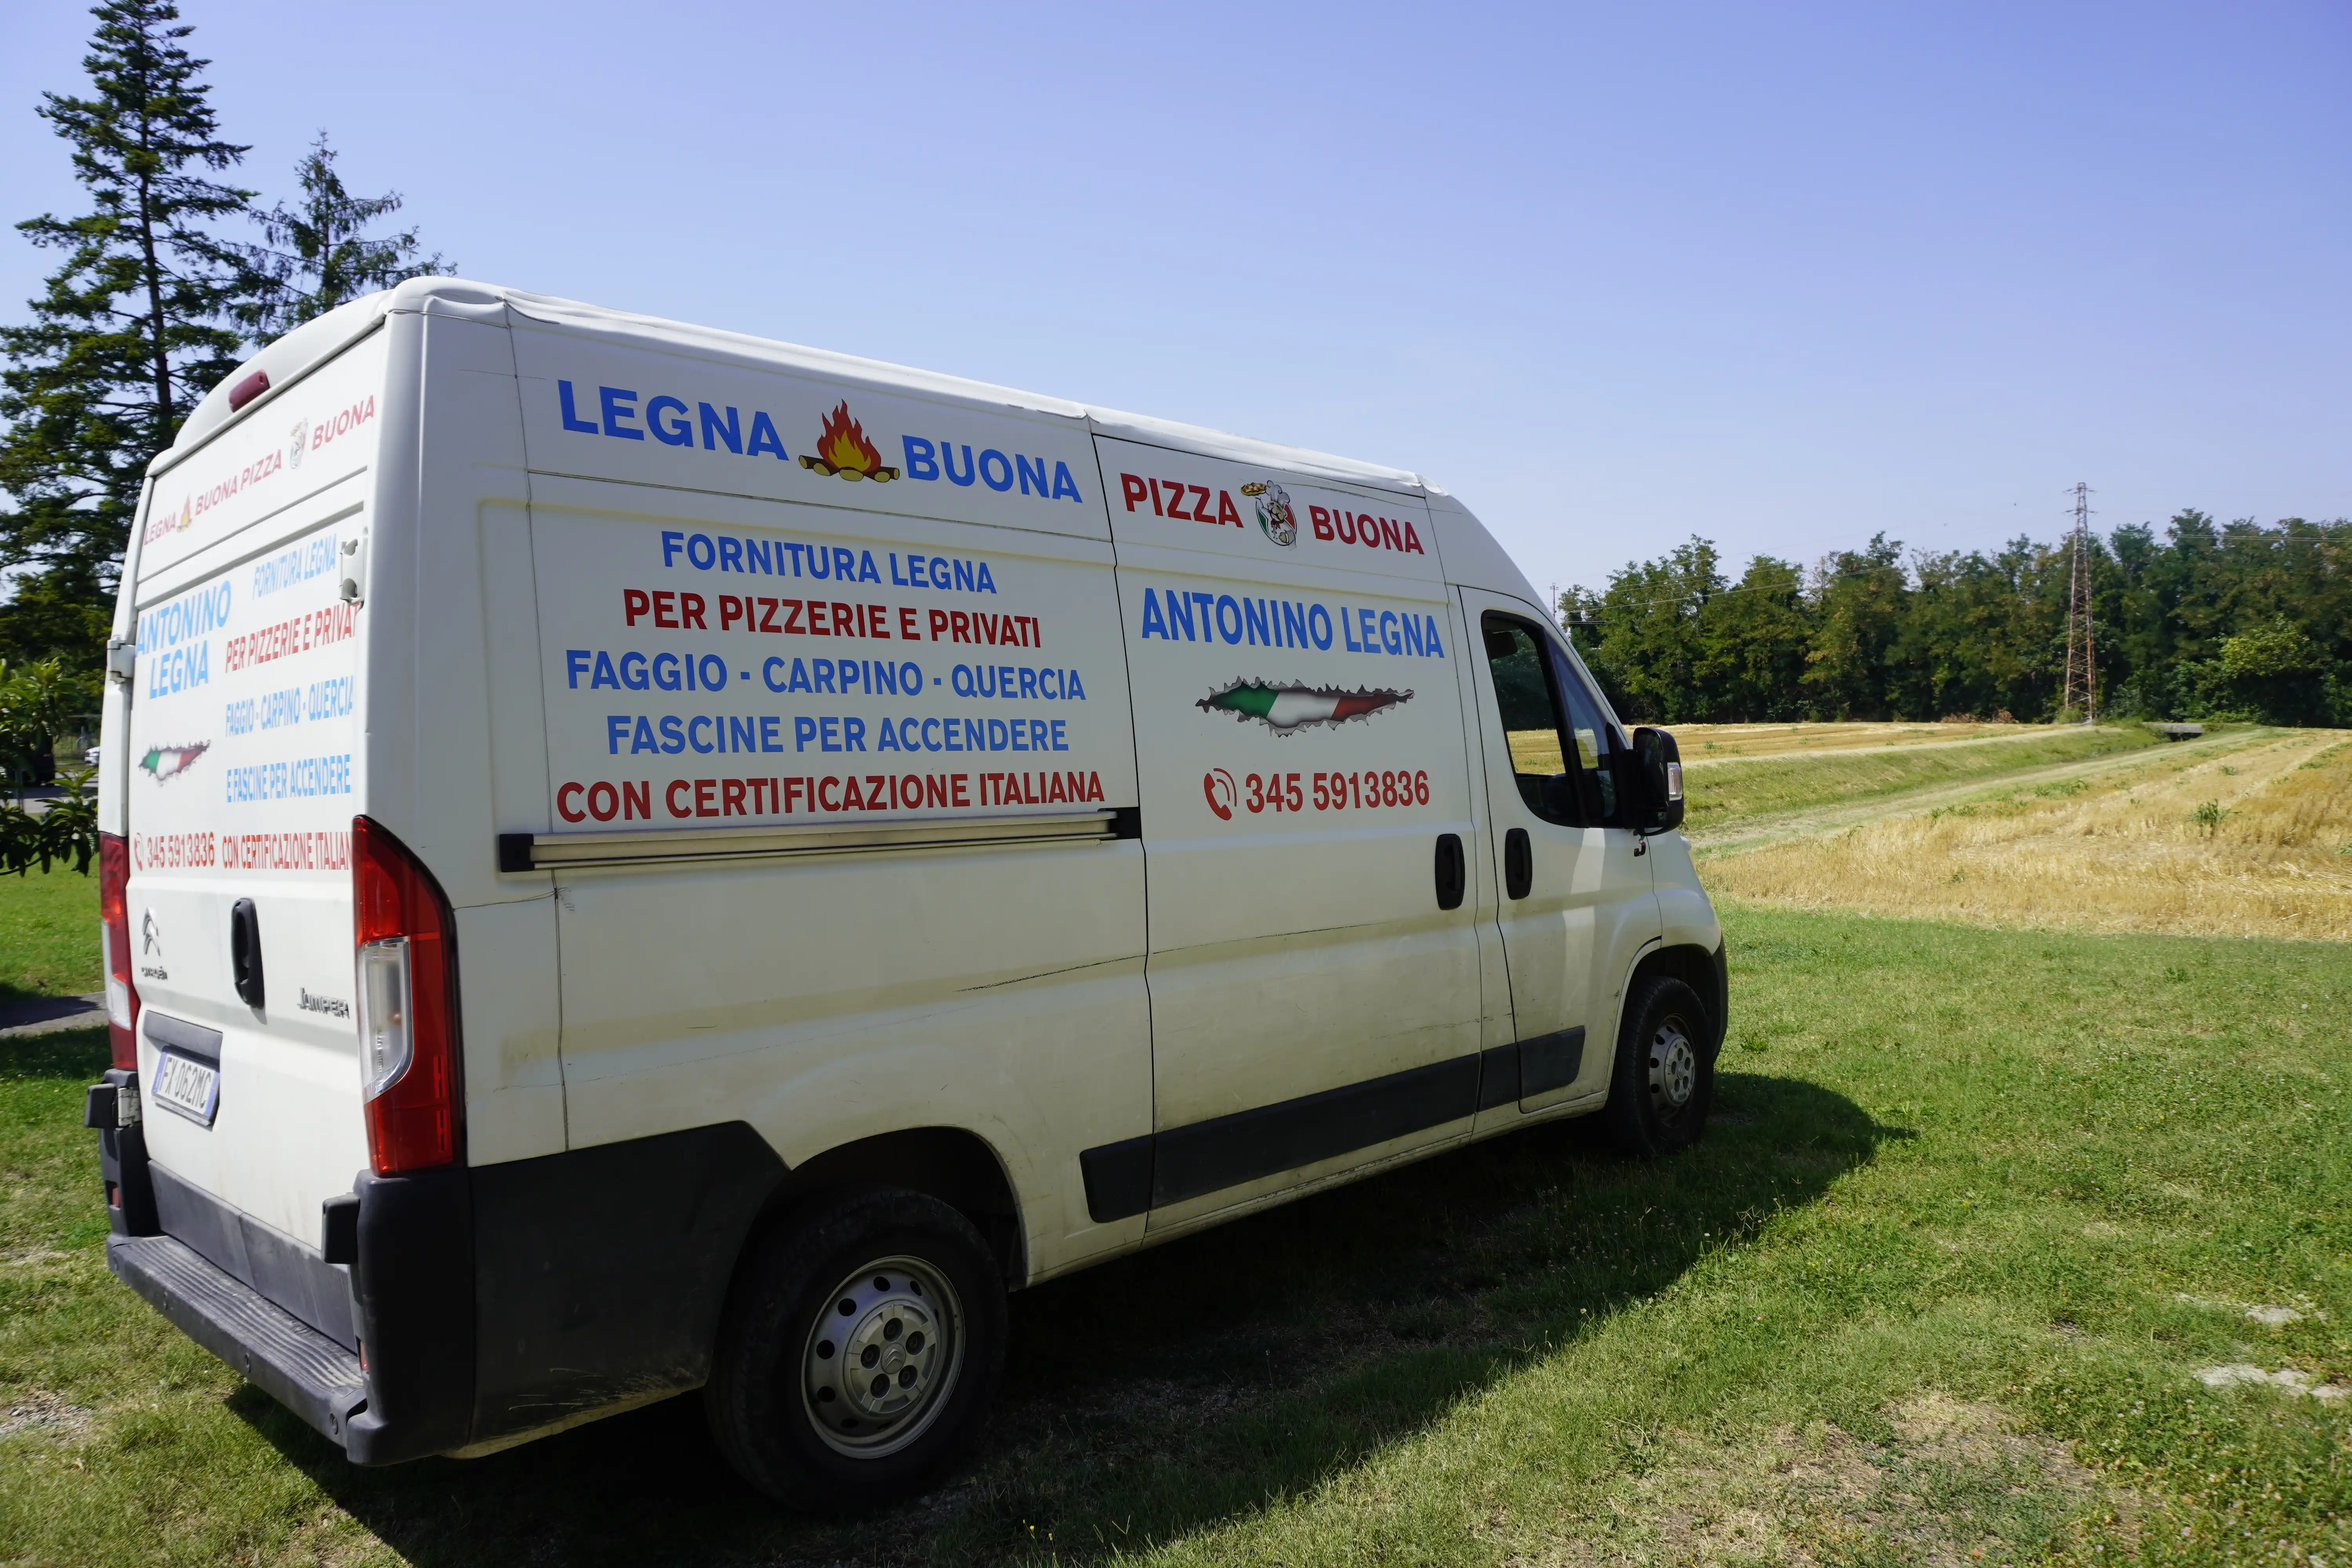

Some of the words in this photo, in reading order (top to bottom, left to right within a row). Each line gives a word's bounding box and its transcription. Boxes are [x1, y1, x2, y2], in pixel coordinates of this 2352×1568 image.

[143, 512, 176, 546] LEGNA
[195, 475, 238, 516] BUONA
[240, 449, 282, 490] PIZZA
[312, 395, 375, 451] BUONA
[557, 380, 788, 460] LEGNA
[902, 435, 1082, 503] BUONA
[1121, 473, 1244, 528] PIZZA
[1309, 505, 1425, 554] BUONA
[253, 548, 301, 600] FORNITURA
[304, 533, 336, 580] LEGNA
[661, 531, 881, 584] FORNITURA
[889, 553, 996, 593] LEGNA
[135, 580, 231, 658] ANTONINO
[225, 635, 246, 673] PER
[248, 617, 300, 666] PIZZERIE
[303, 613, 312, 651] E
[314, 602, 360, 648] PRIVAT
[624, 588, 707, 630] PER
[719, 595, 890, 639] PIZZERIE
[899, 608, 920, 640] E
[929, 610, 1040, 648] PRIVATI
[1142, 588, 1332, 650] ANTONINO
[1341, 607, 1444, 657] LEGNA
[149, 640, 209, 699] LEGNA
[566, 650, 727, 691] FAGGIO
[762, 656, 923, 695] CARPINO
[952, 664, 1085, 700] QUERCIA
[225, 698, 254, 737] FAGGIO
[261, 686, 301, 730] CARPINO
[607, 715, 783, 754] FASCINE
[795, 717, 866, 752] PER
[878, 717, 1069, 751] ACCENDERE
[227, 769, 232, 802] E
[234, 764, 267, 802] FASCINE
[270, 762, 287, 799] PER
[290, 753, 351, 797] ACCENDERE
[557, 781, 651, 822] CON
[666, 774, 970, 818] CERTIFICAZIONE
[980, 771, 1104, 806] ITALIANA
[1246, 773, 1303, 813] 345
[1313, 770, 1429, 810] 5913836
[147, 836, 165, 868] 345
[168, 831, 215, 867] 5913836
[222, 835, 240, 869] CON
[241, 832, 314, 869] CERTIFICAZIONE
[315, 831, 353, 870] ITALIAN
